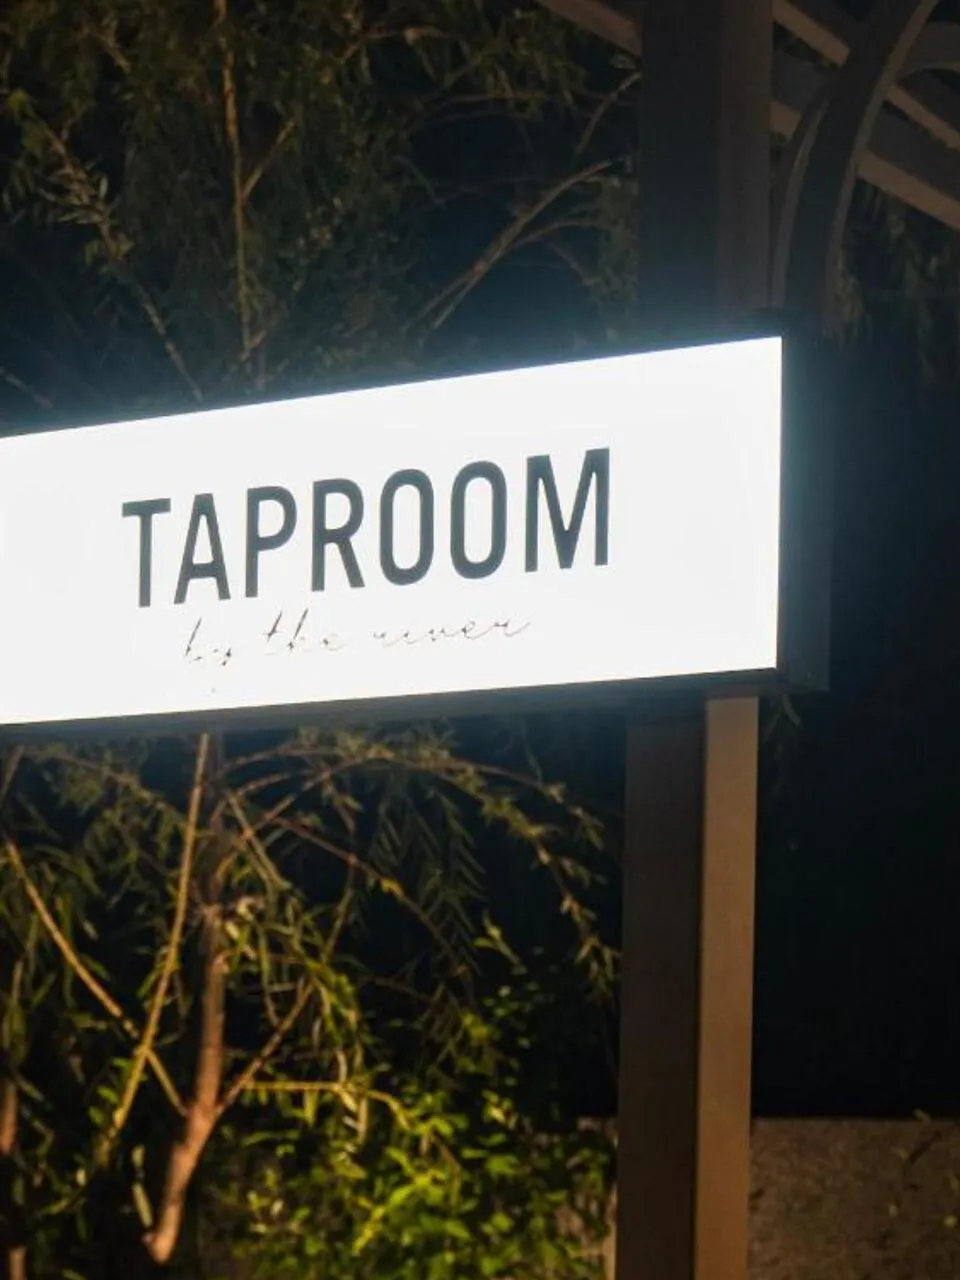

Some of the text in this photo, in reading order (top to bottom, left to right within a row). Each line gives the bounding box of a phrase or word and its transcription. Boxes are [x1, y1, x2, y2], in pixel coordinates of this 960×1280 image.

[122, 448, 610, 606] TAPROOM
[262, 607, 345, 656] the
[371, 614, 531, 649] river
